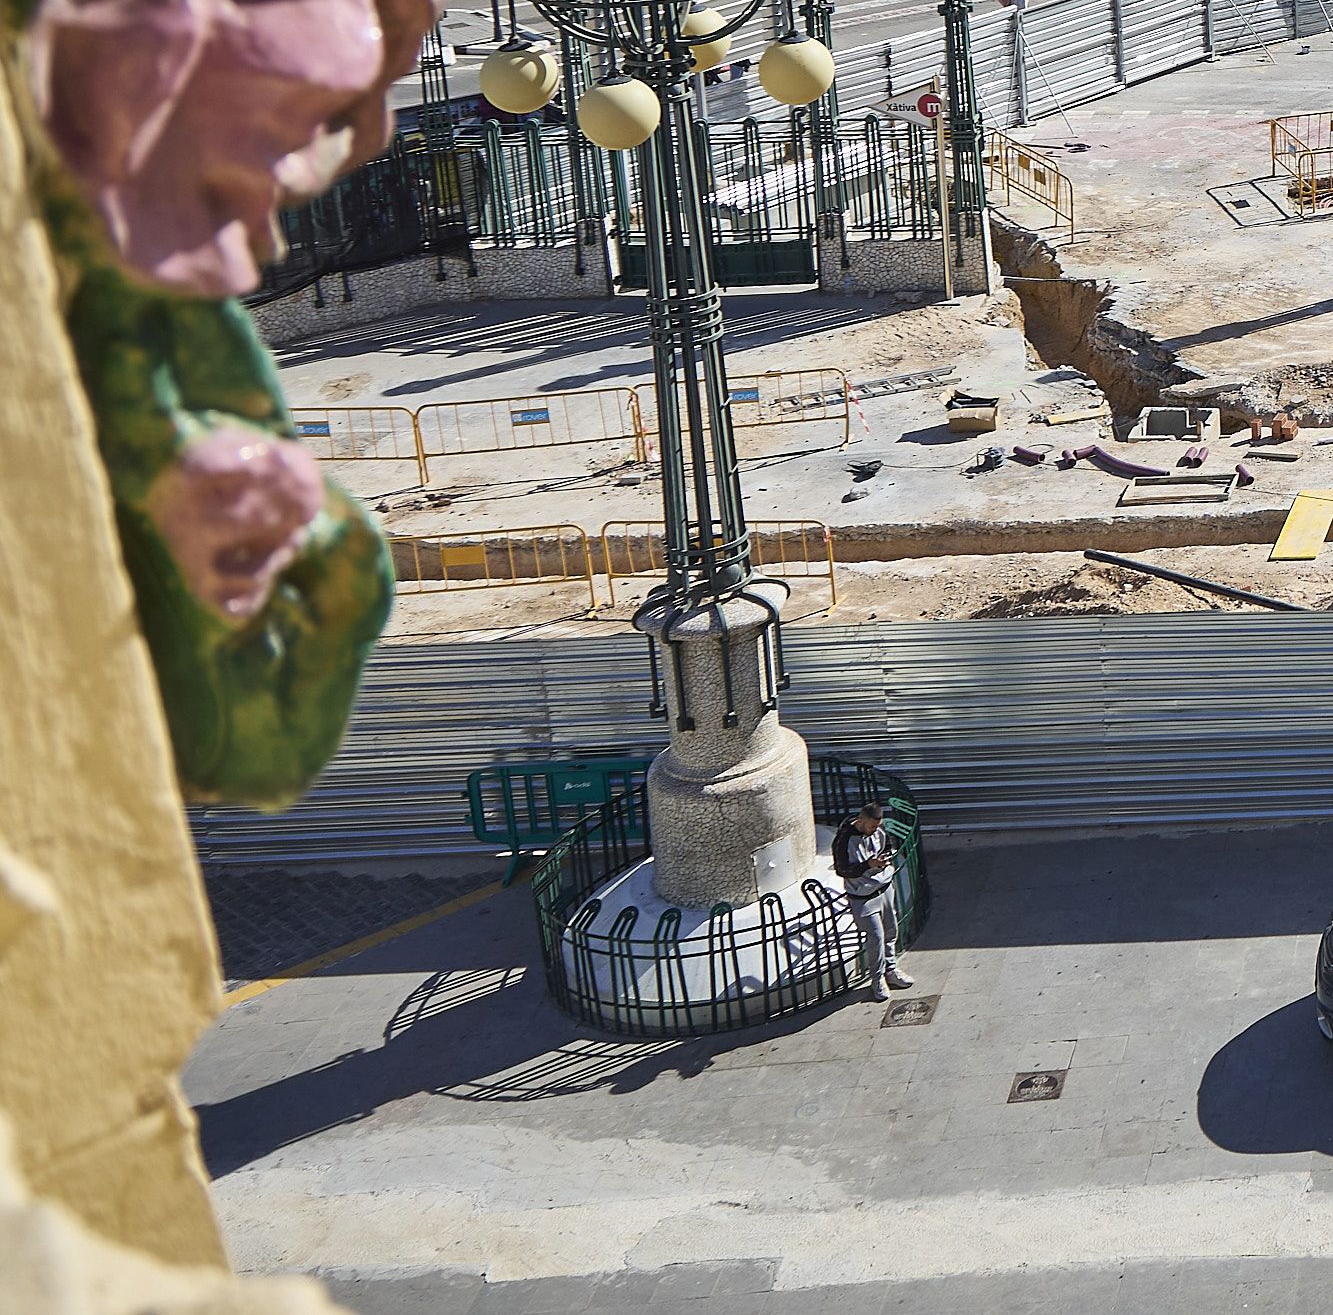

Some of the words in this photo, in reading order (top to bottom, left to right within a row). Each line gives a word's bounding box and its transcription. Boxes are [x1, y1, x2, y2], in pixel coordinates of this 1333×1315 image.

[886, 102, 917, 111] Xàtiva
[734, 392, 759, 401] rover
[523, 412, 548, 422] rover
[303, 426, 329, 435] rover
